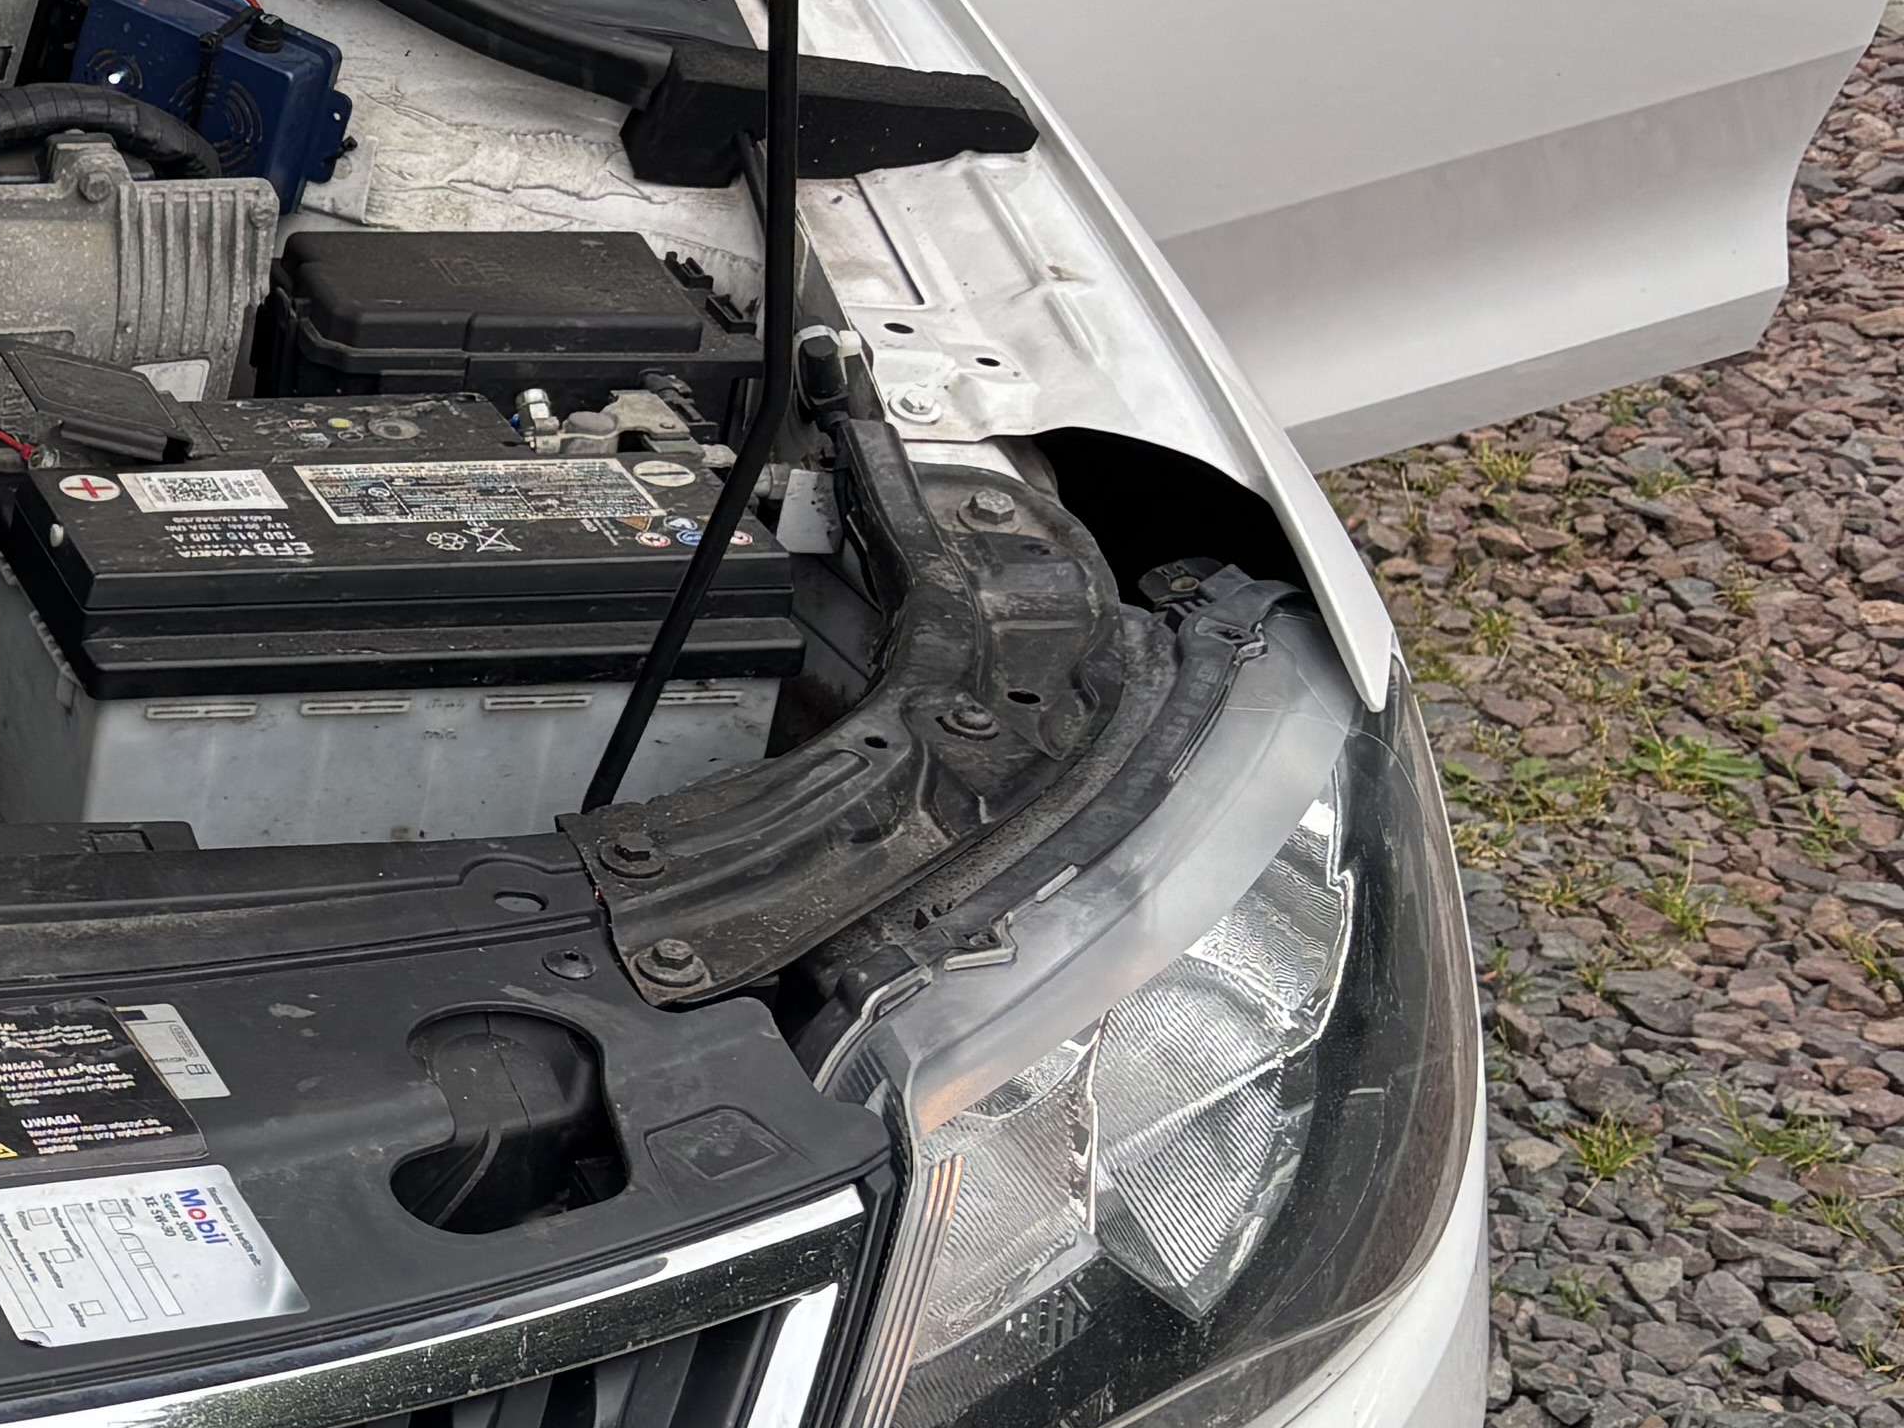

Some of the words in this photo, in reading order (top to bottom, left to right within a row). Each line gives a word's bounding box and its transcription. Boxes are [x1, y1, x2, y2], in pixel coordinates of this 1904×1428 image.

[253, 542, 315, 556] EFB
[20, 1114, 82, 1129] UWAGA!
[142, 1196, 159, 1208] XE
[160, 1193, 181, 1219] Super
[150, 1209, 177, 1237] 5W-30
[175, 1188, 230, 1244] Mobil
